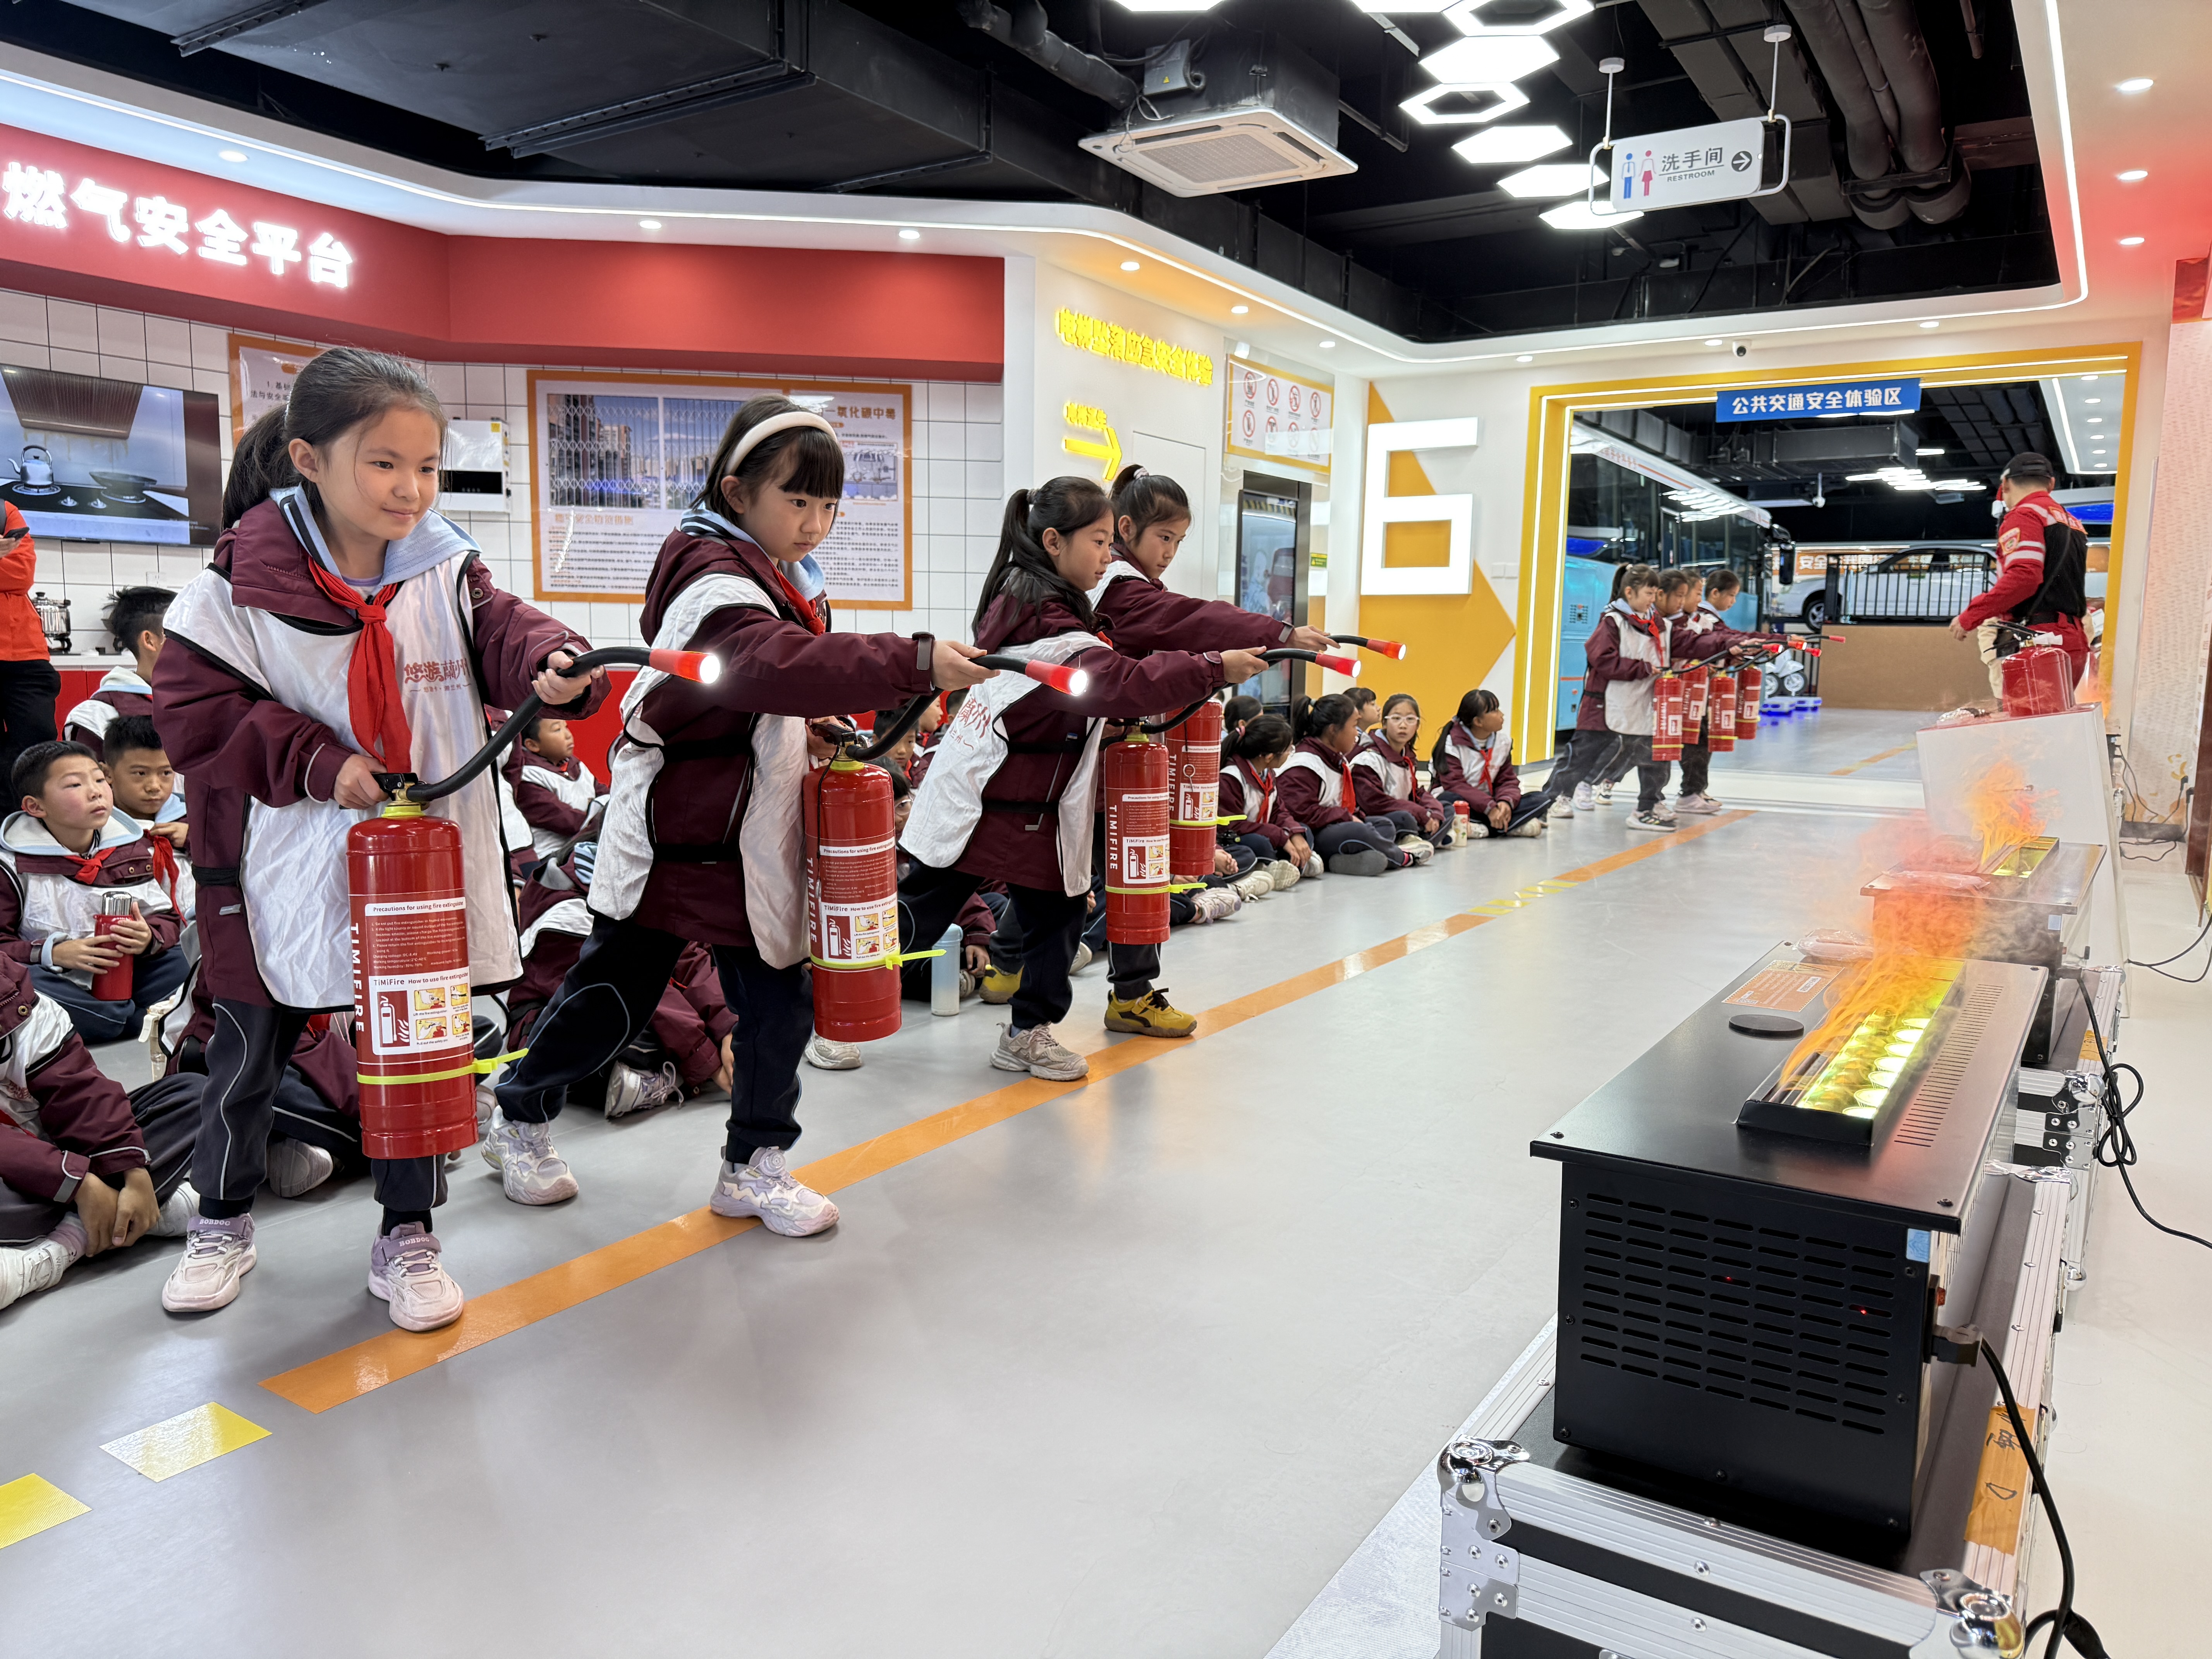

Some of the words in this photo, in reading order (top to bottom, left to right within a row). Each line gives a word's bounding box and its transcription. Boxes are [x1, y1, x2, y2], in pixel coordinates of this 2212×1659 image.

[1661, 147, 1723, 172] 洗手间
[1667, 170, 1715, 182] RESTROOM
[2, 161, 354, 288] 燃气安全平台
[1732, 387, 1901, 415] 公共交通安全体验区
[1361, 417, 1479, 595] 6
[1169, 754, 1177, 812] TIMIFIRE
[1109, 805, 1118, 870] TIMIFIRE
[807, 858, 817, 942] TIMIFIRE
[350, 922, 364, 1032] TIMIFIRE
[398, 1237, 429, 1247] BOBDOG
